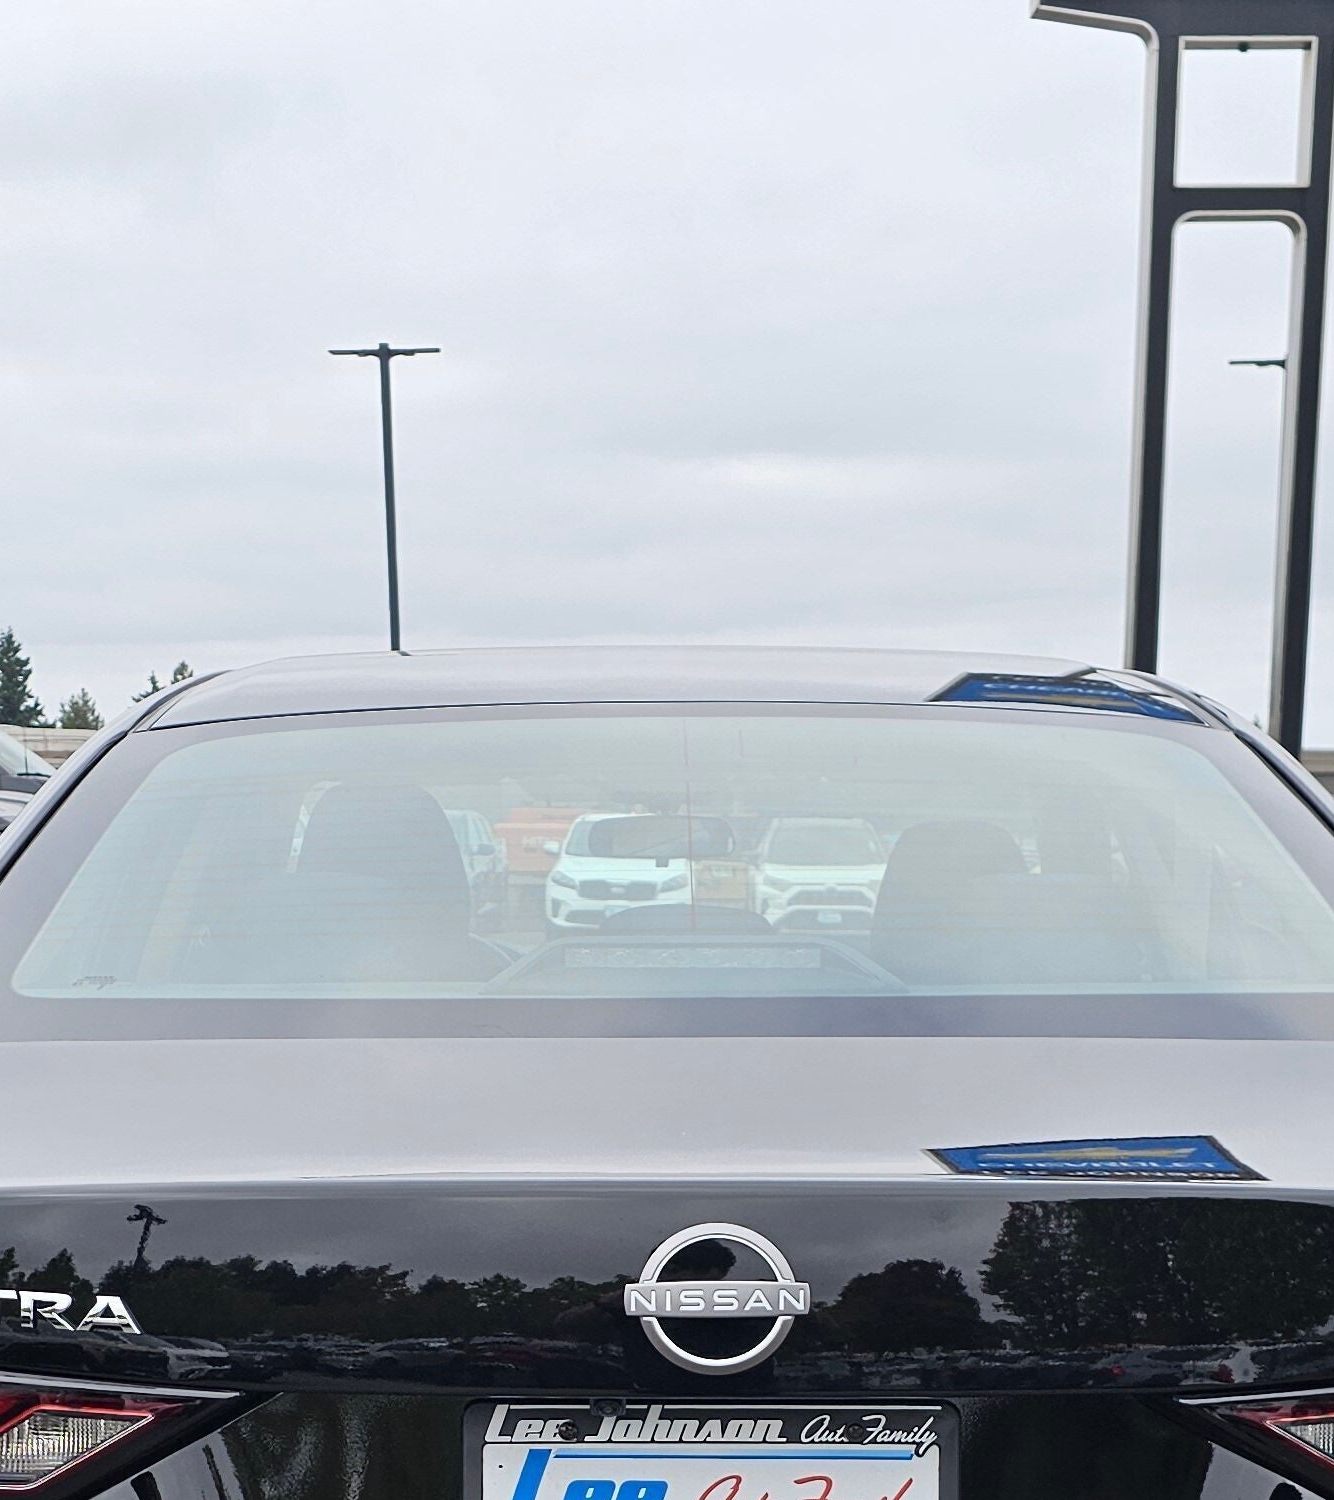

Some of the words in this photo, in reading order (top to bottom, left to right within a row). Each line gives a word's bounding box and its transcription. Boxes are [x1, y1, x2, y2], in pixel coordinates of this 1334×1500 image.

[630, 1289, 805, 1312] NISSAN
[800, 1414, 863, 1443] Aut
[862, 1414, 938, 1456] Family
